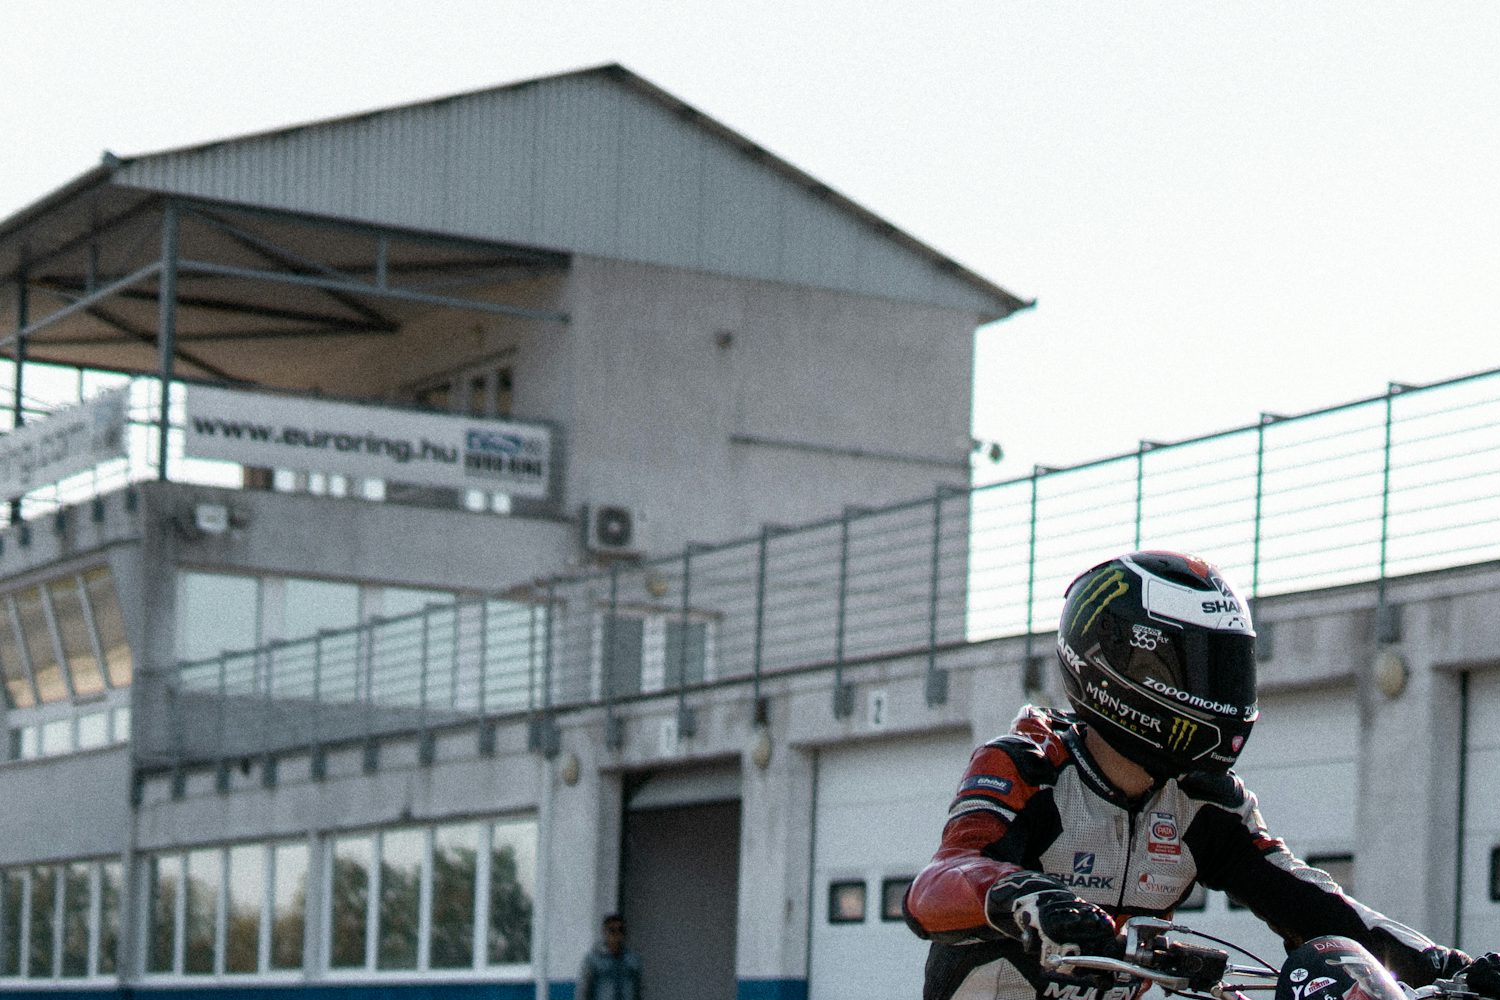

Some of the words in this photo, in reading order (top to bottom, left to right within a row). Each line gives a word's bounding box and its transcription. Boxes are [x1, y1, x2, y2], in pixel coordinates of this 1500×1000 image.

[191, 416, 459, 464] www.euroring.hu
[1201, 600, 1242, 614] SHA
[1086, 681, 1162, 733] MONSTER
